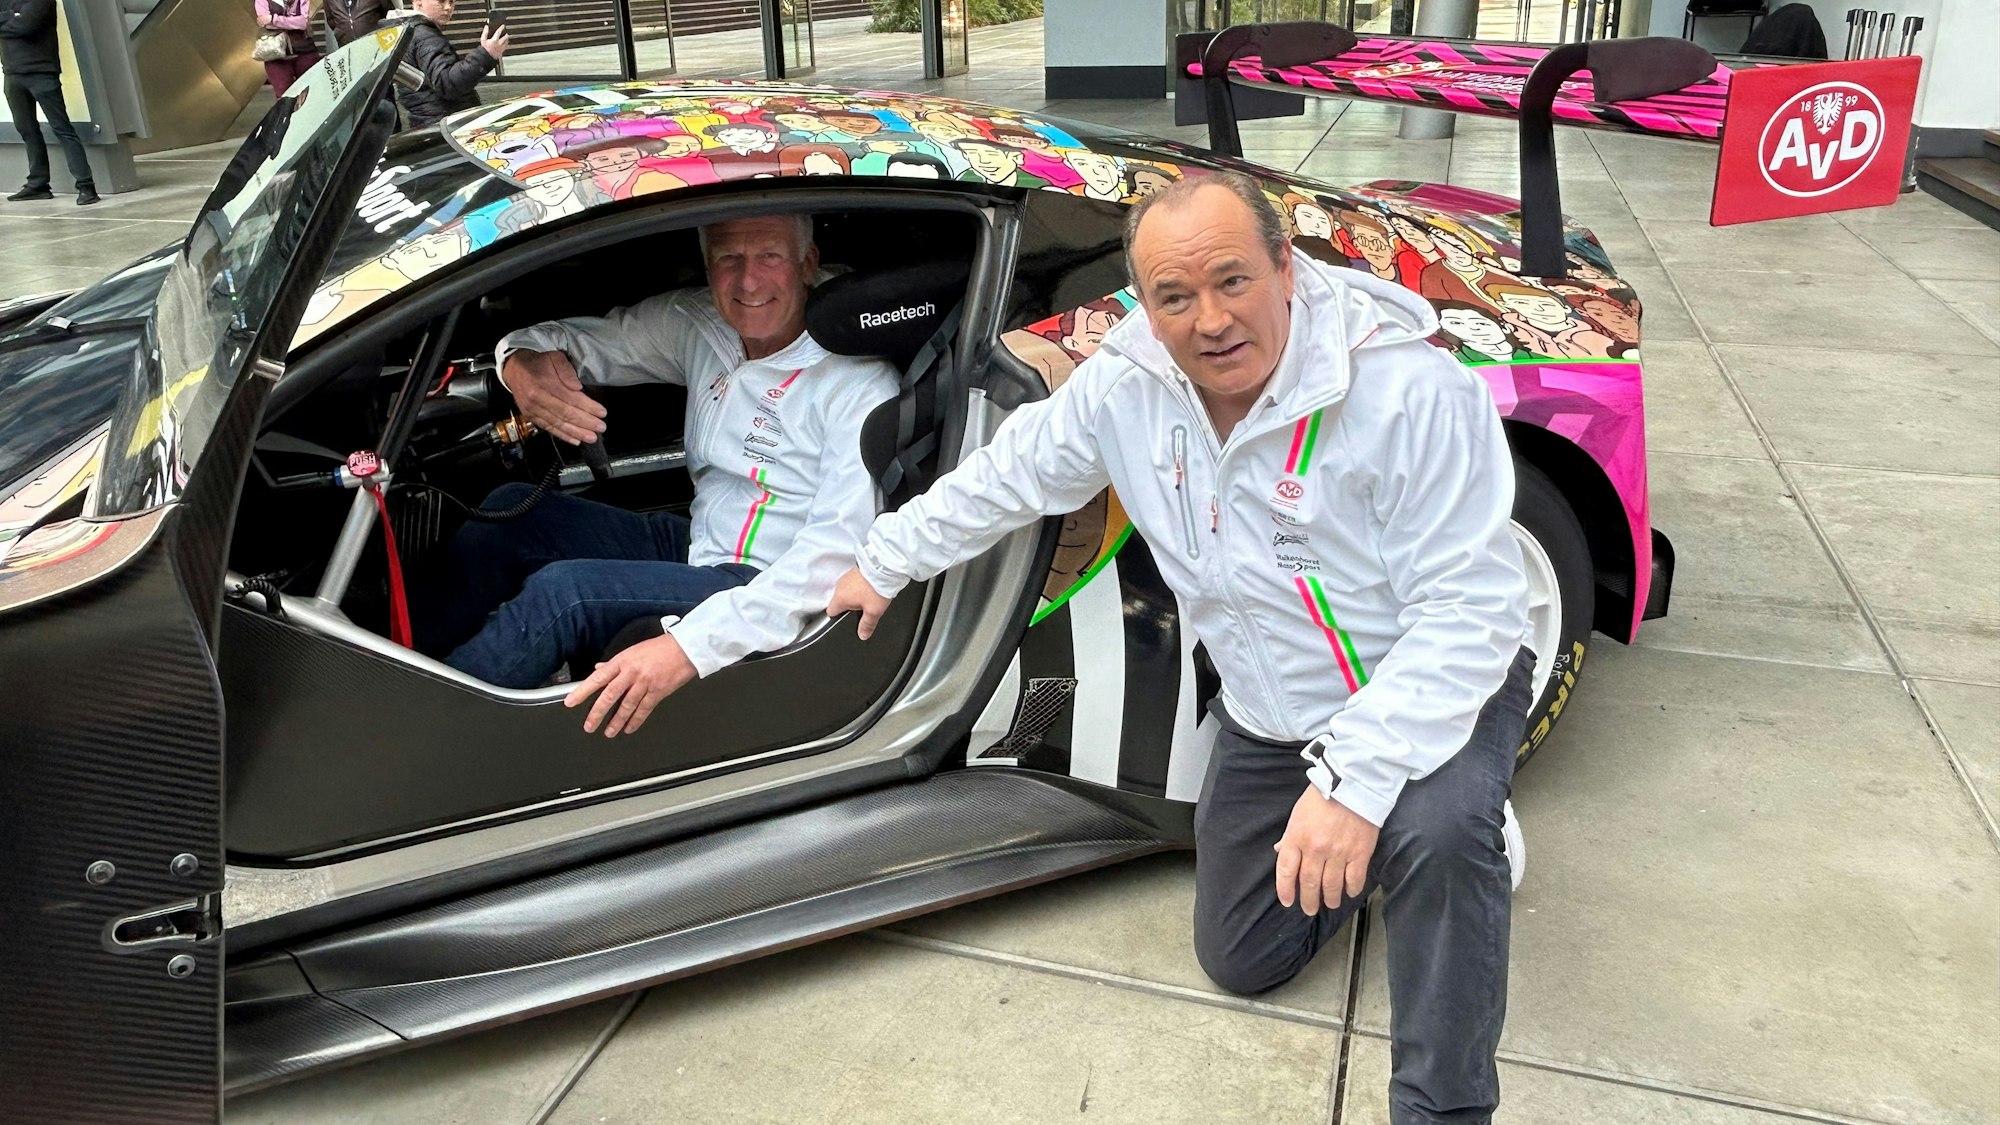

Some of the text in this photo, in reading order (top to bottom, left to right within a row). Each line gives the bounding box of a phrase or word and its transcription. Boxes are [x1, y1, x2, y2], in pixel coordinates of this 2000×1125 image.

[1801, 95, 1859, 112] 18 99
[859, 301, 936, 329] Racetech
[350, 455, 376, 468] PUSH
